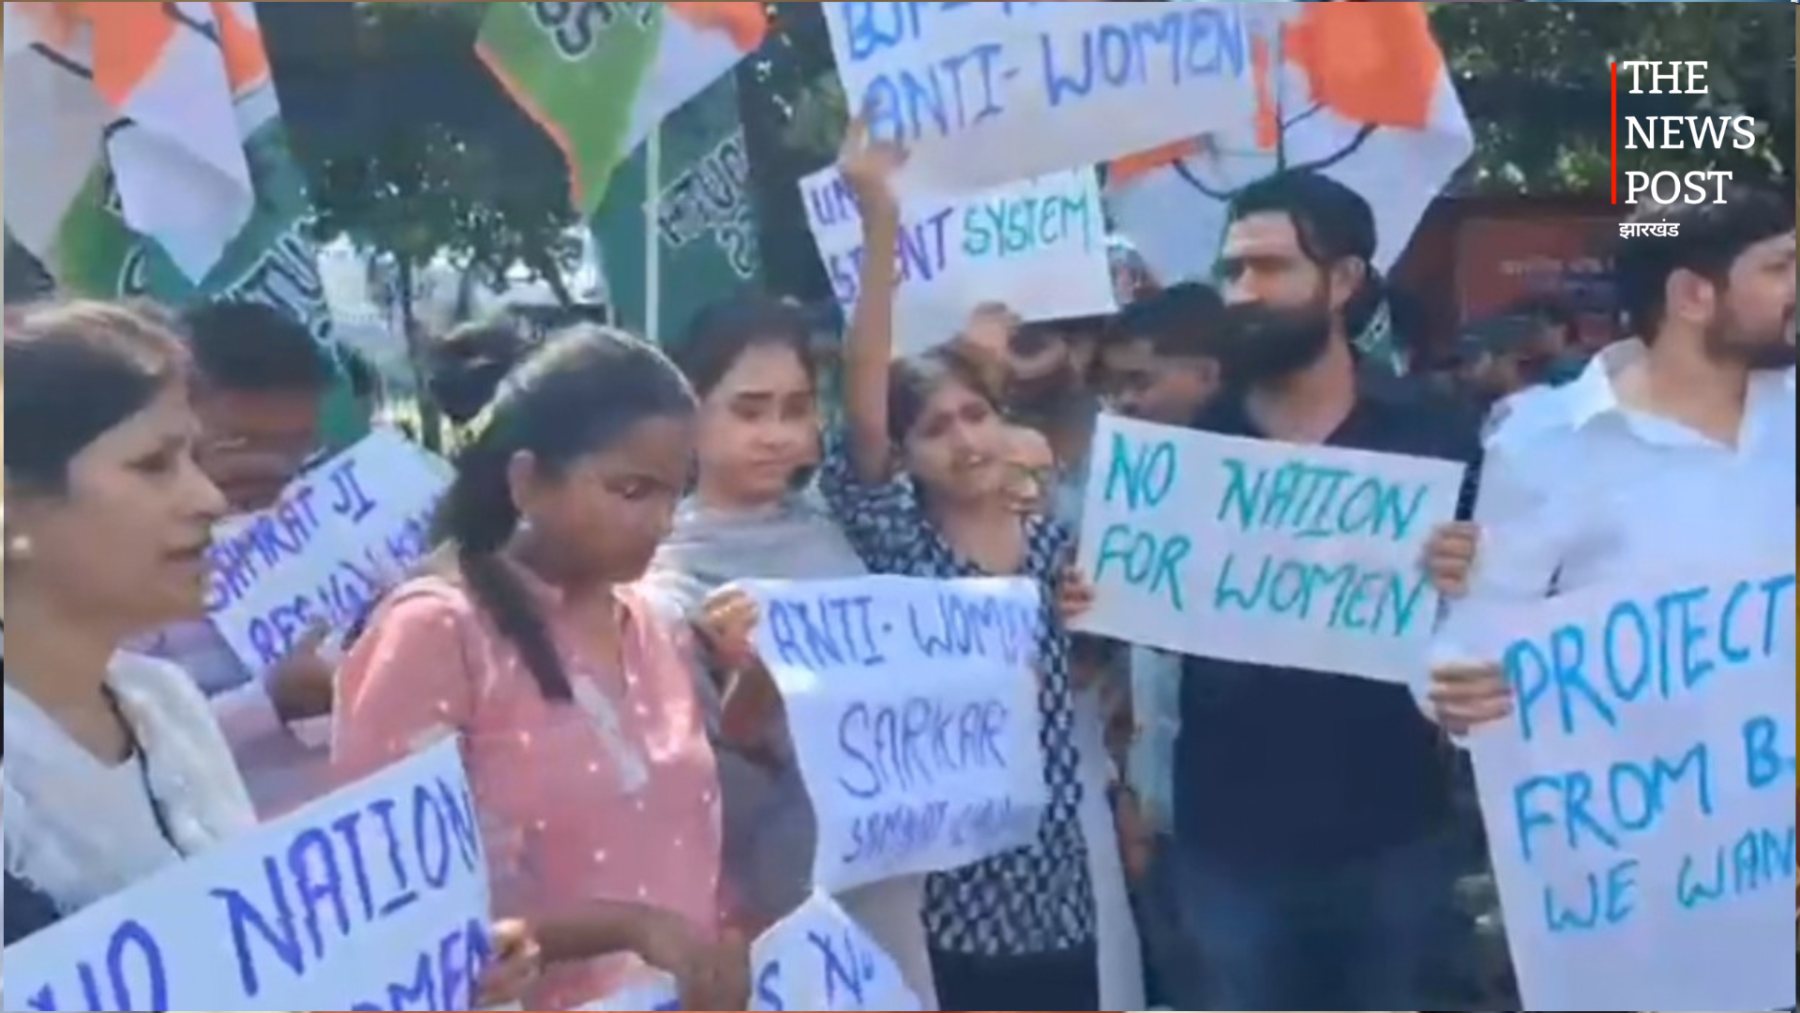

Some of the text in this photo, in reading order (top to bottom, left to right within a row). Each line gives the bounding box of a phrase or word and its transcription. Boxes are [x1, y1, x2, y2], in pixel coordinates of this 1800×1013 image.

[963, 193, 1092, 258] SYSTEM
[329, 458, 376, 524] JI
[1104, 431, 1428, 542] NO NATION
[1095, 524, 1432, 636] FOR WOMEN
[1504, 574, 1796, 740] PROTECT
[1514, 742, 1712, 861] FROM
[210, 777, 480, 998] NATION
[1544, 859, 1640, 932] WE
